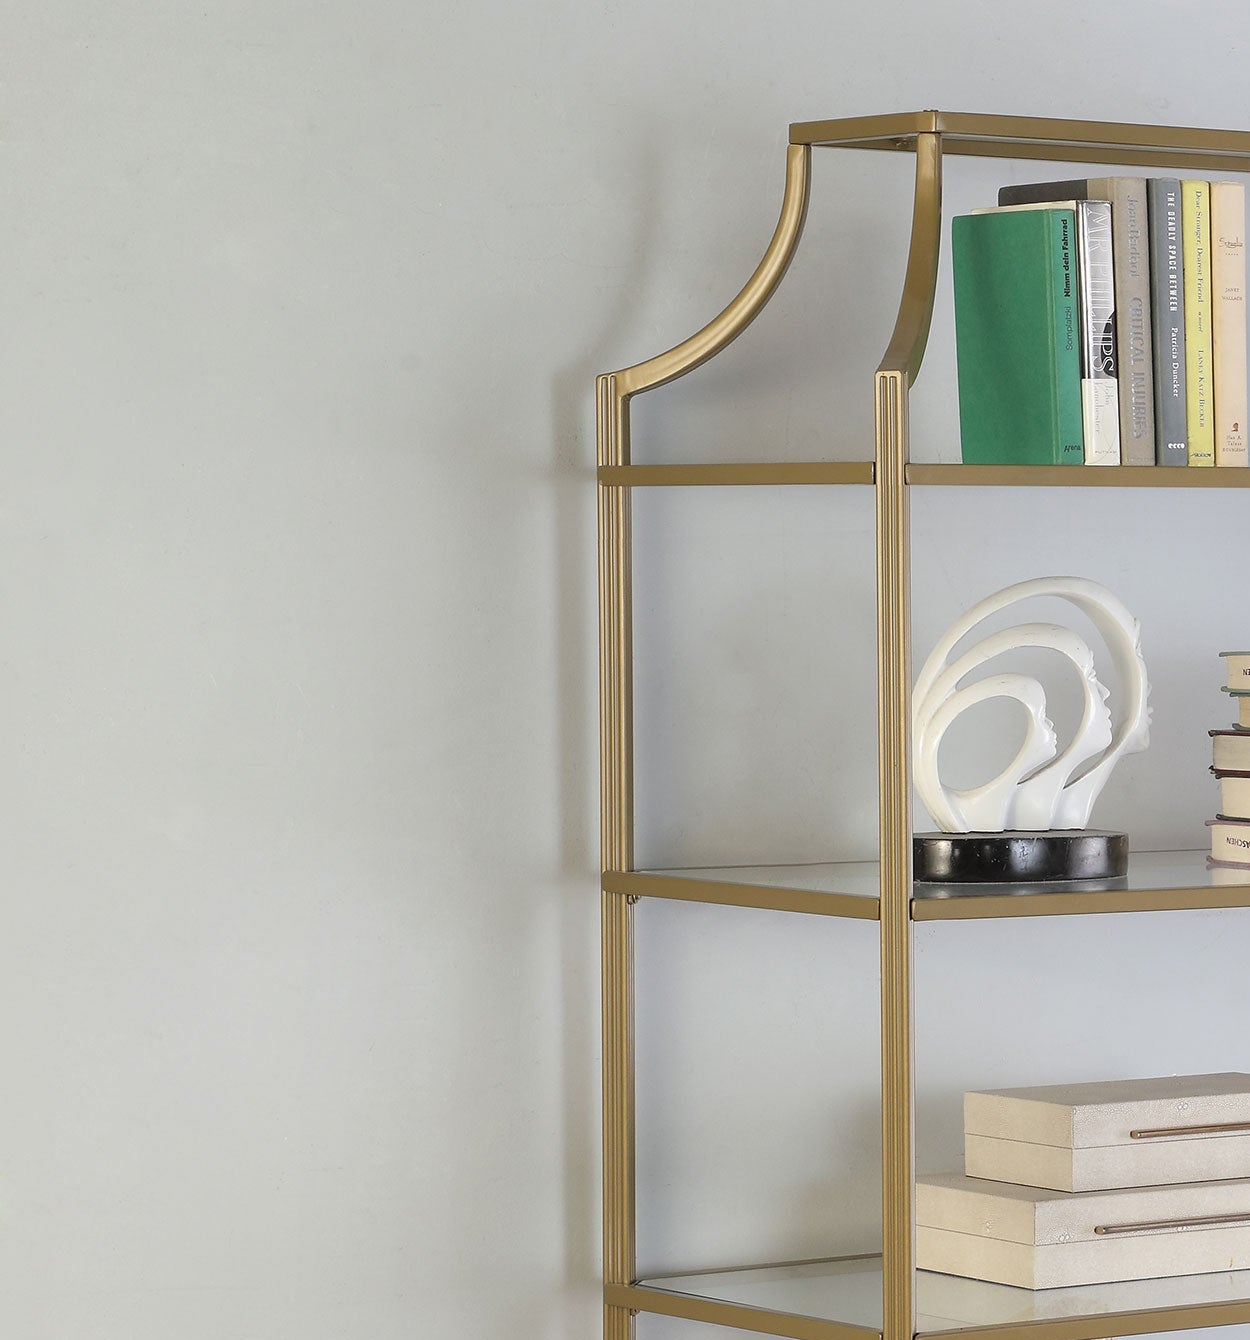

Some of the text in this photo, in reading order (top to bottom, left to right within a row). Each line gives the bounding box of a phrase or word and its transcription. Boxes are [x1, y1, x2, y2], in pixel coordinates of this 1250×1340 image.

[1167, 192, 1178, 312] THE DEADLY SPACE BETWEEN
[1087, 207, 1115, 372] MR PHILLIPS
[1129, 297, 1145, 365] CRITICAL
[1170, 327, 1180, 398] Patricia Duncker
[1131, 372, 1147, 440] INJURIES
[1168, 442, 1185, 450] ecco
